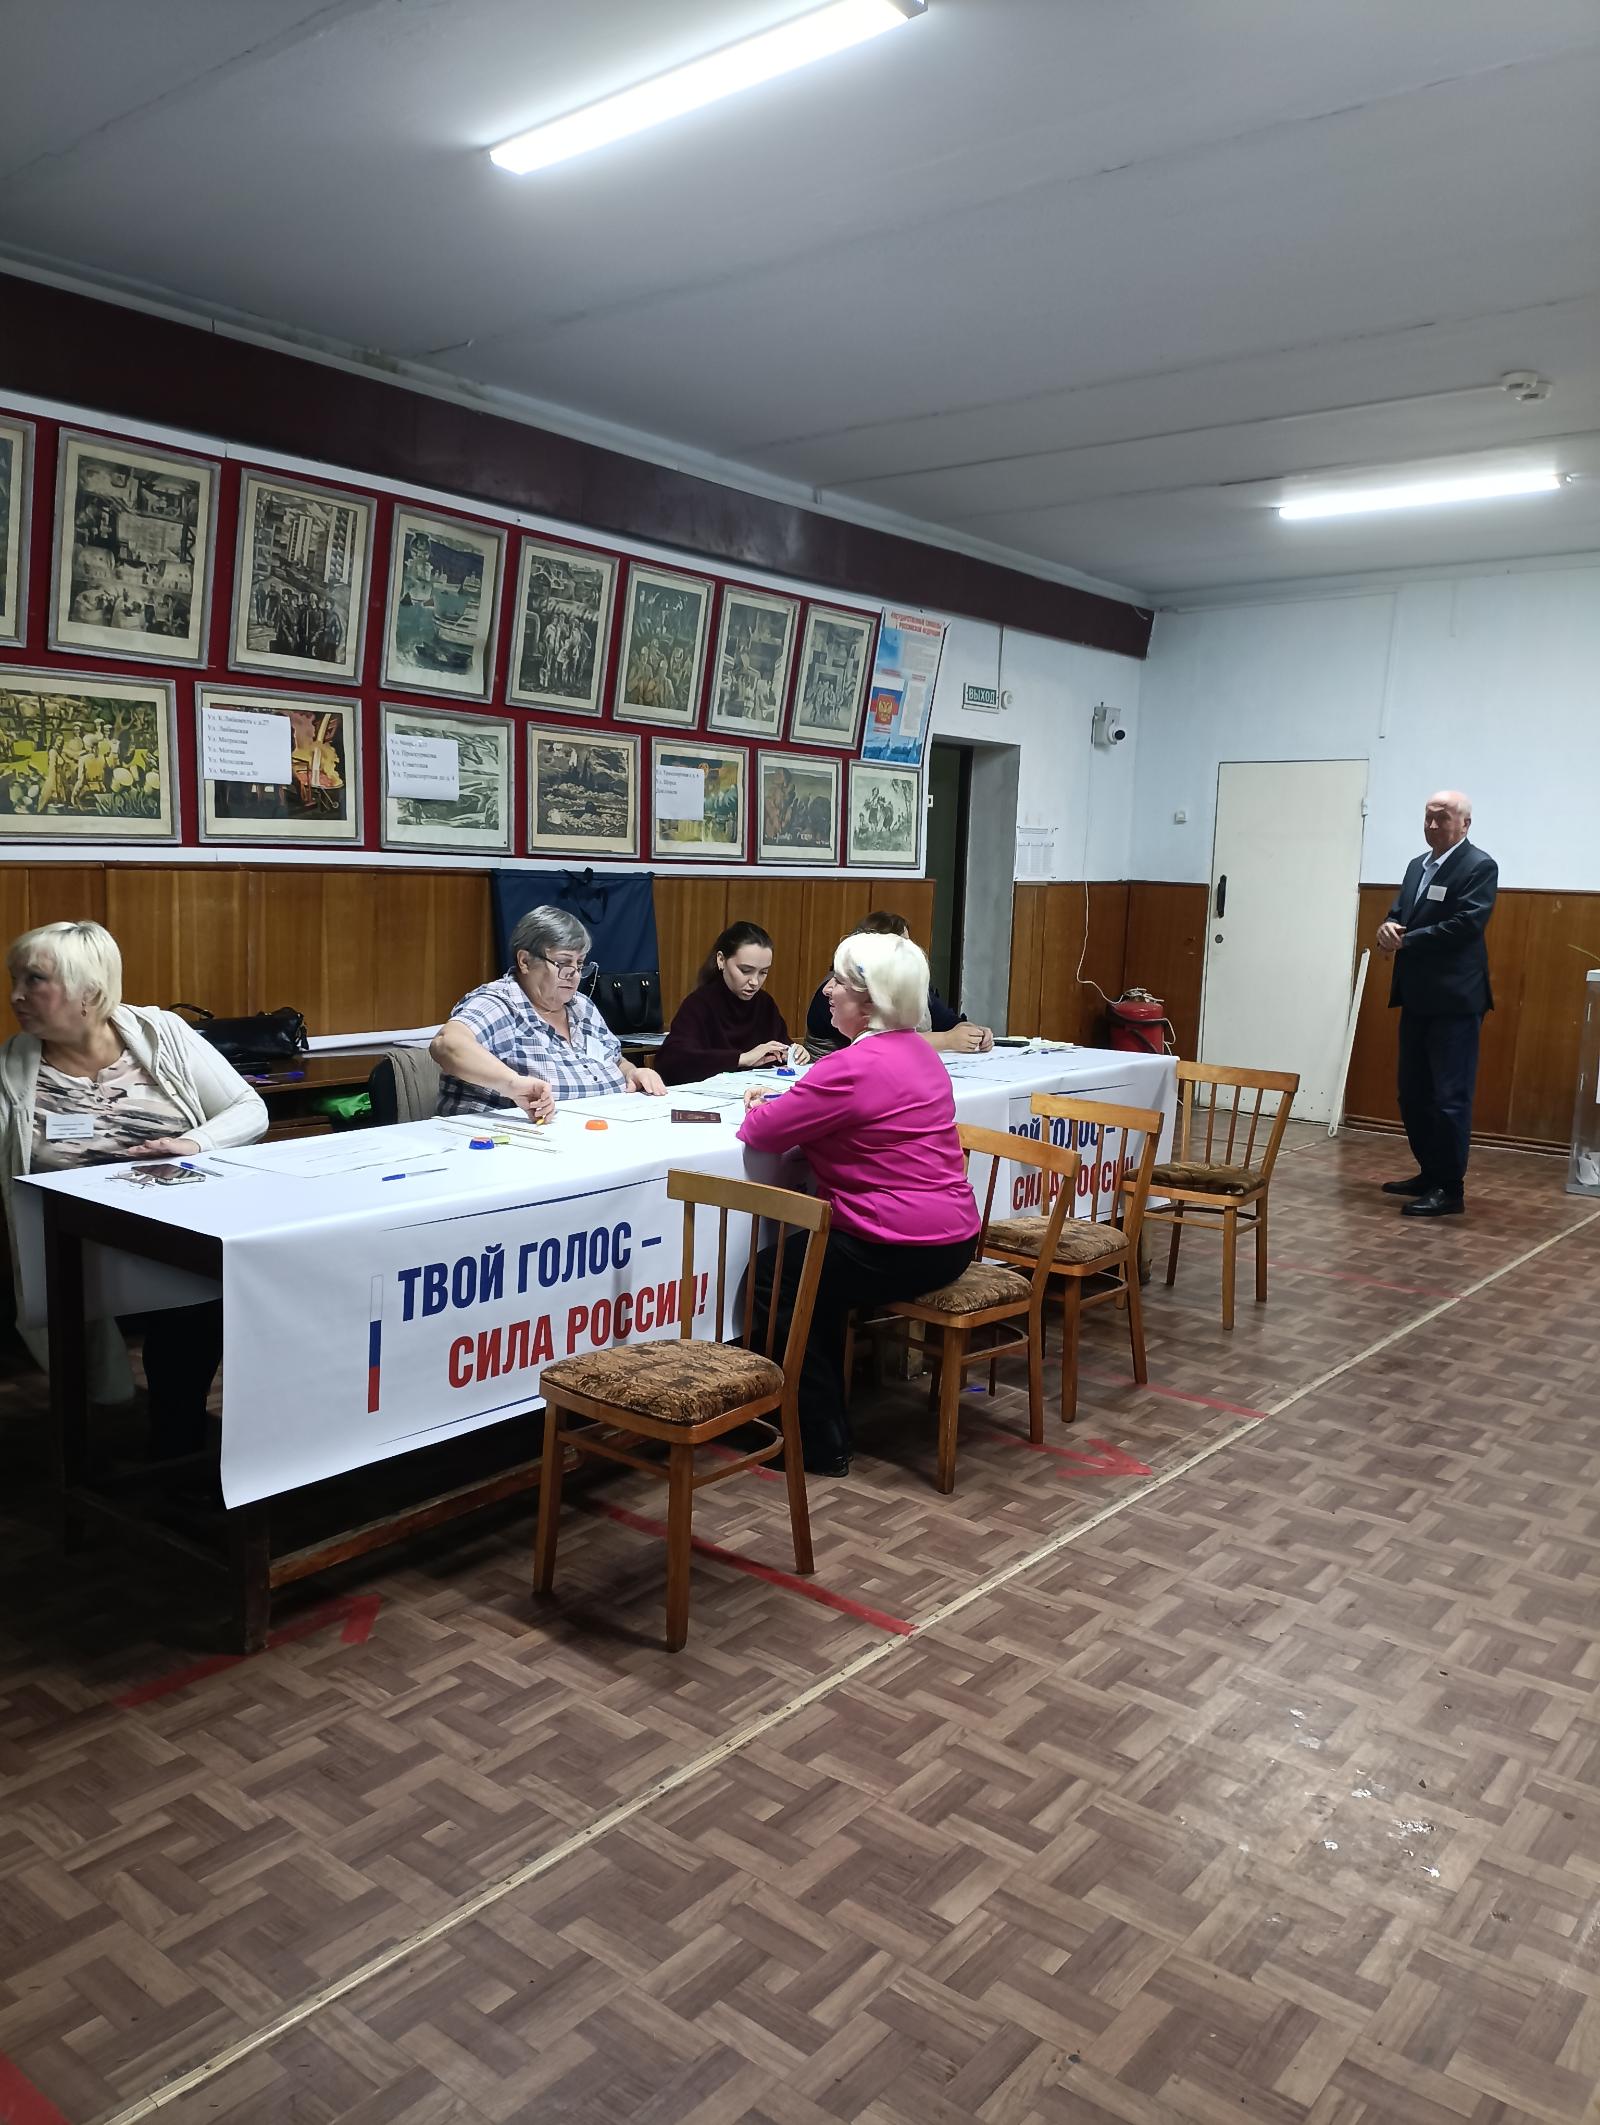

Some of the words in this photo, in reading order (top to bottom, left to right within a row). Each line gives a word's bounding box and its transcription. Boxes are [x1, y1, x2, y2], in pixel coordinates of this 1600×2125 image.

[968, 687, 995, 704] ВЫХОД
[397, 1242, 506, 1322] ТВОЙ
[517, 1221, 632, 1294] ГОЛОС
[448, 1314, 555, 1389] СИЛА
